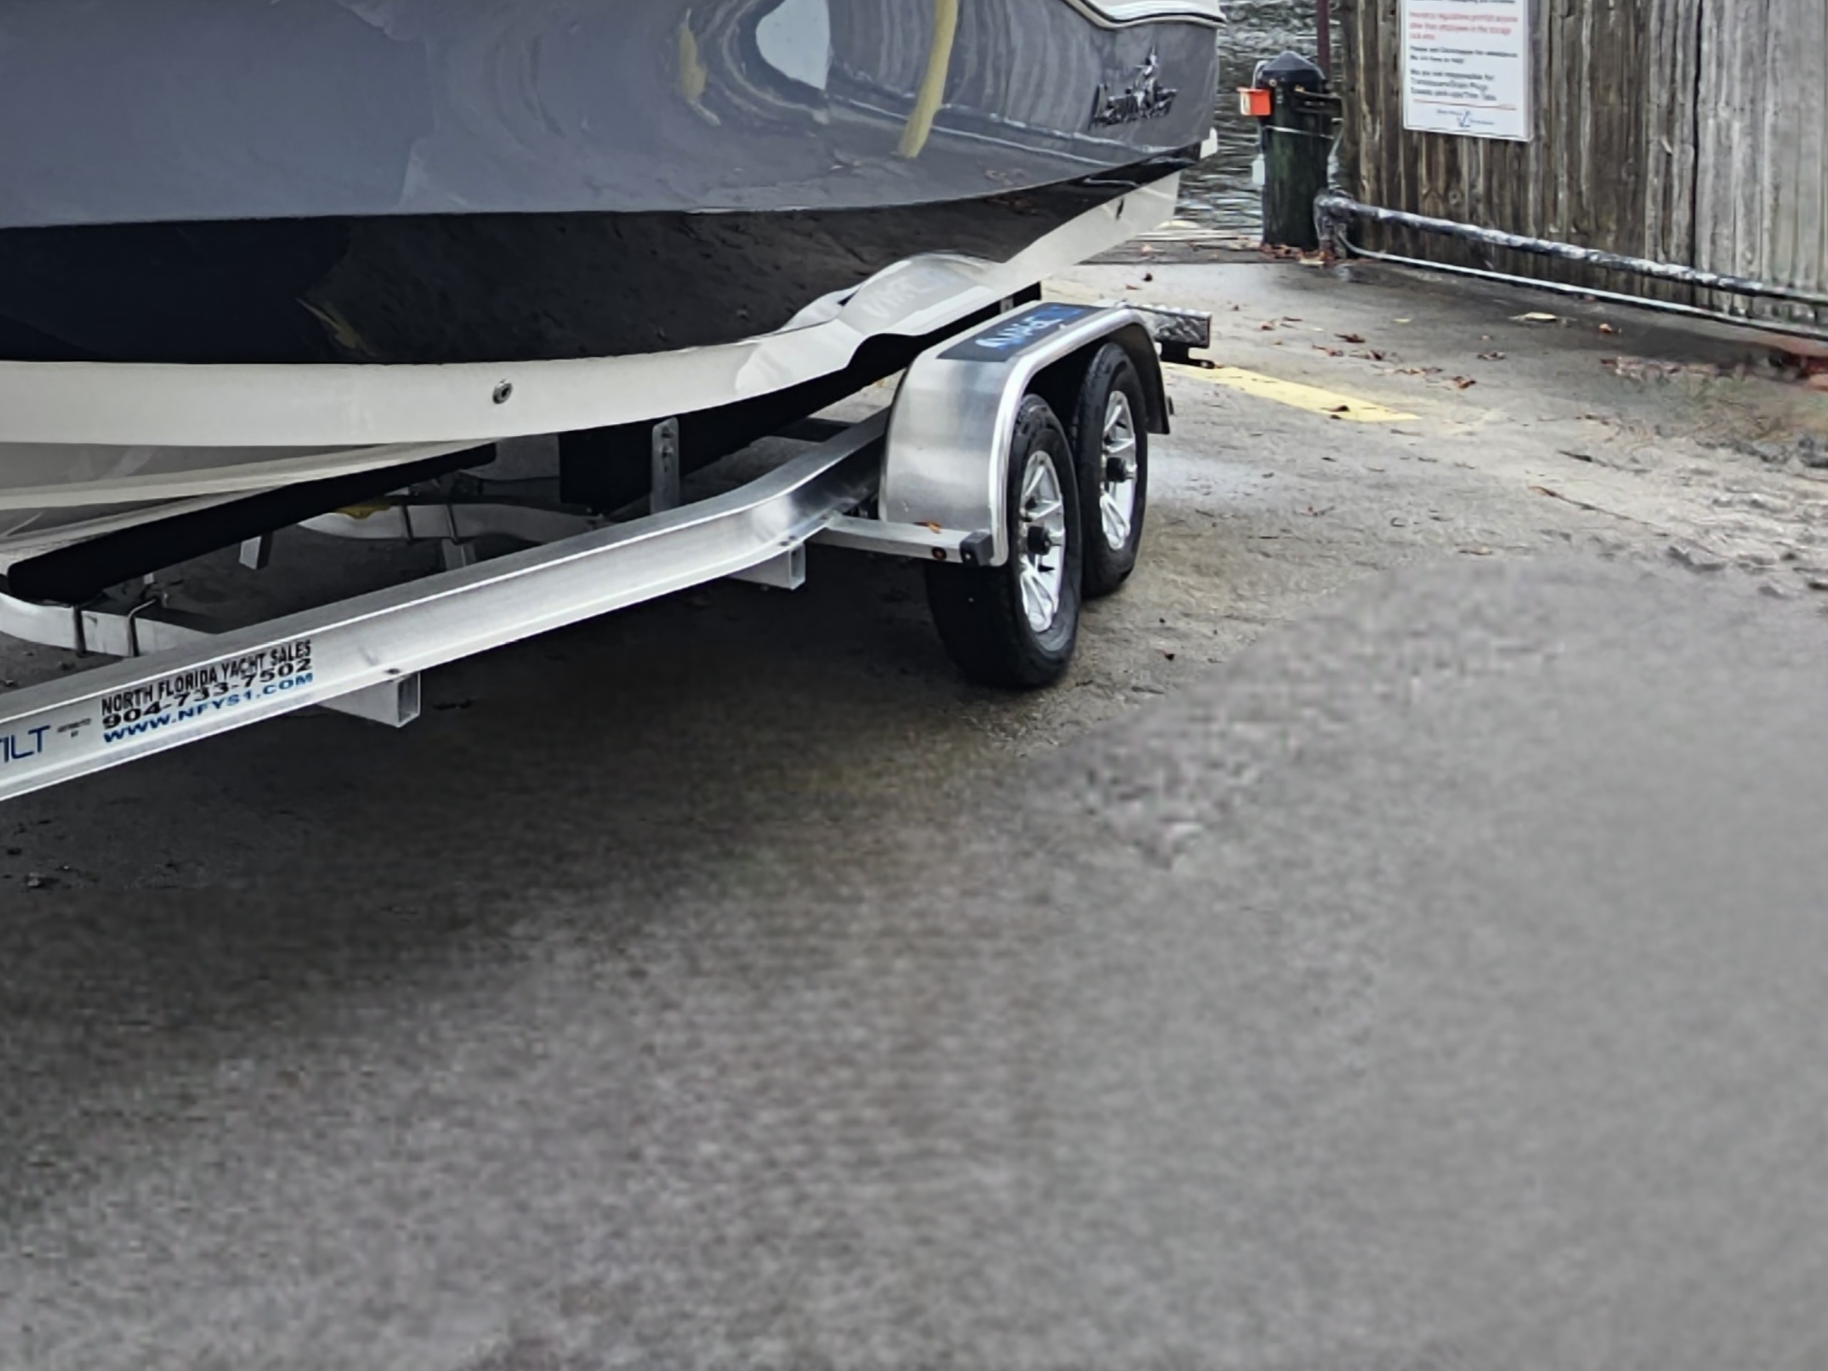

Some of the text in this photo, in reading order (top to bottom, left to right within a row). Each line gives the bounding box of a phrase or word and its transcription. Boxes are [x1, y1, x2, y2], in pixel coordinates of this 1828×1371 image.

[102, 639, 312, 716] NORTH FLORIDA YACHT SALES
[102, 658, 313, 729] 904-733-7502
[103, 672, 314, 743] WWW.NFYS1.COM
